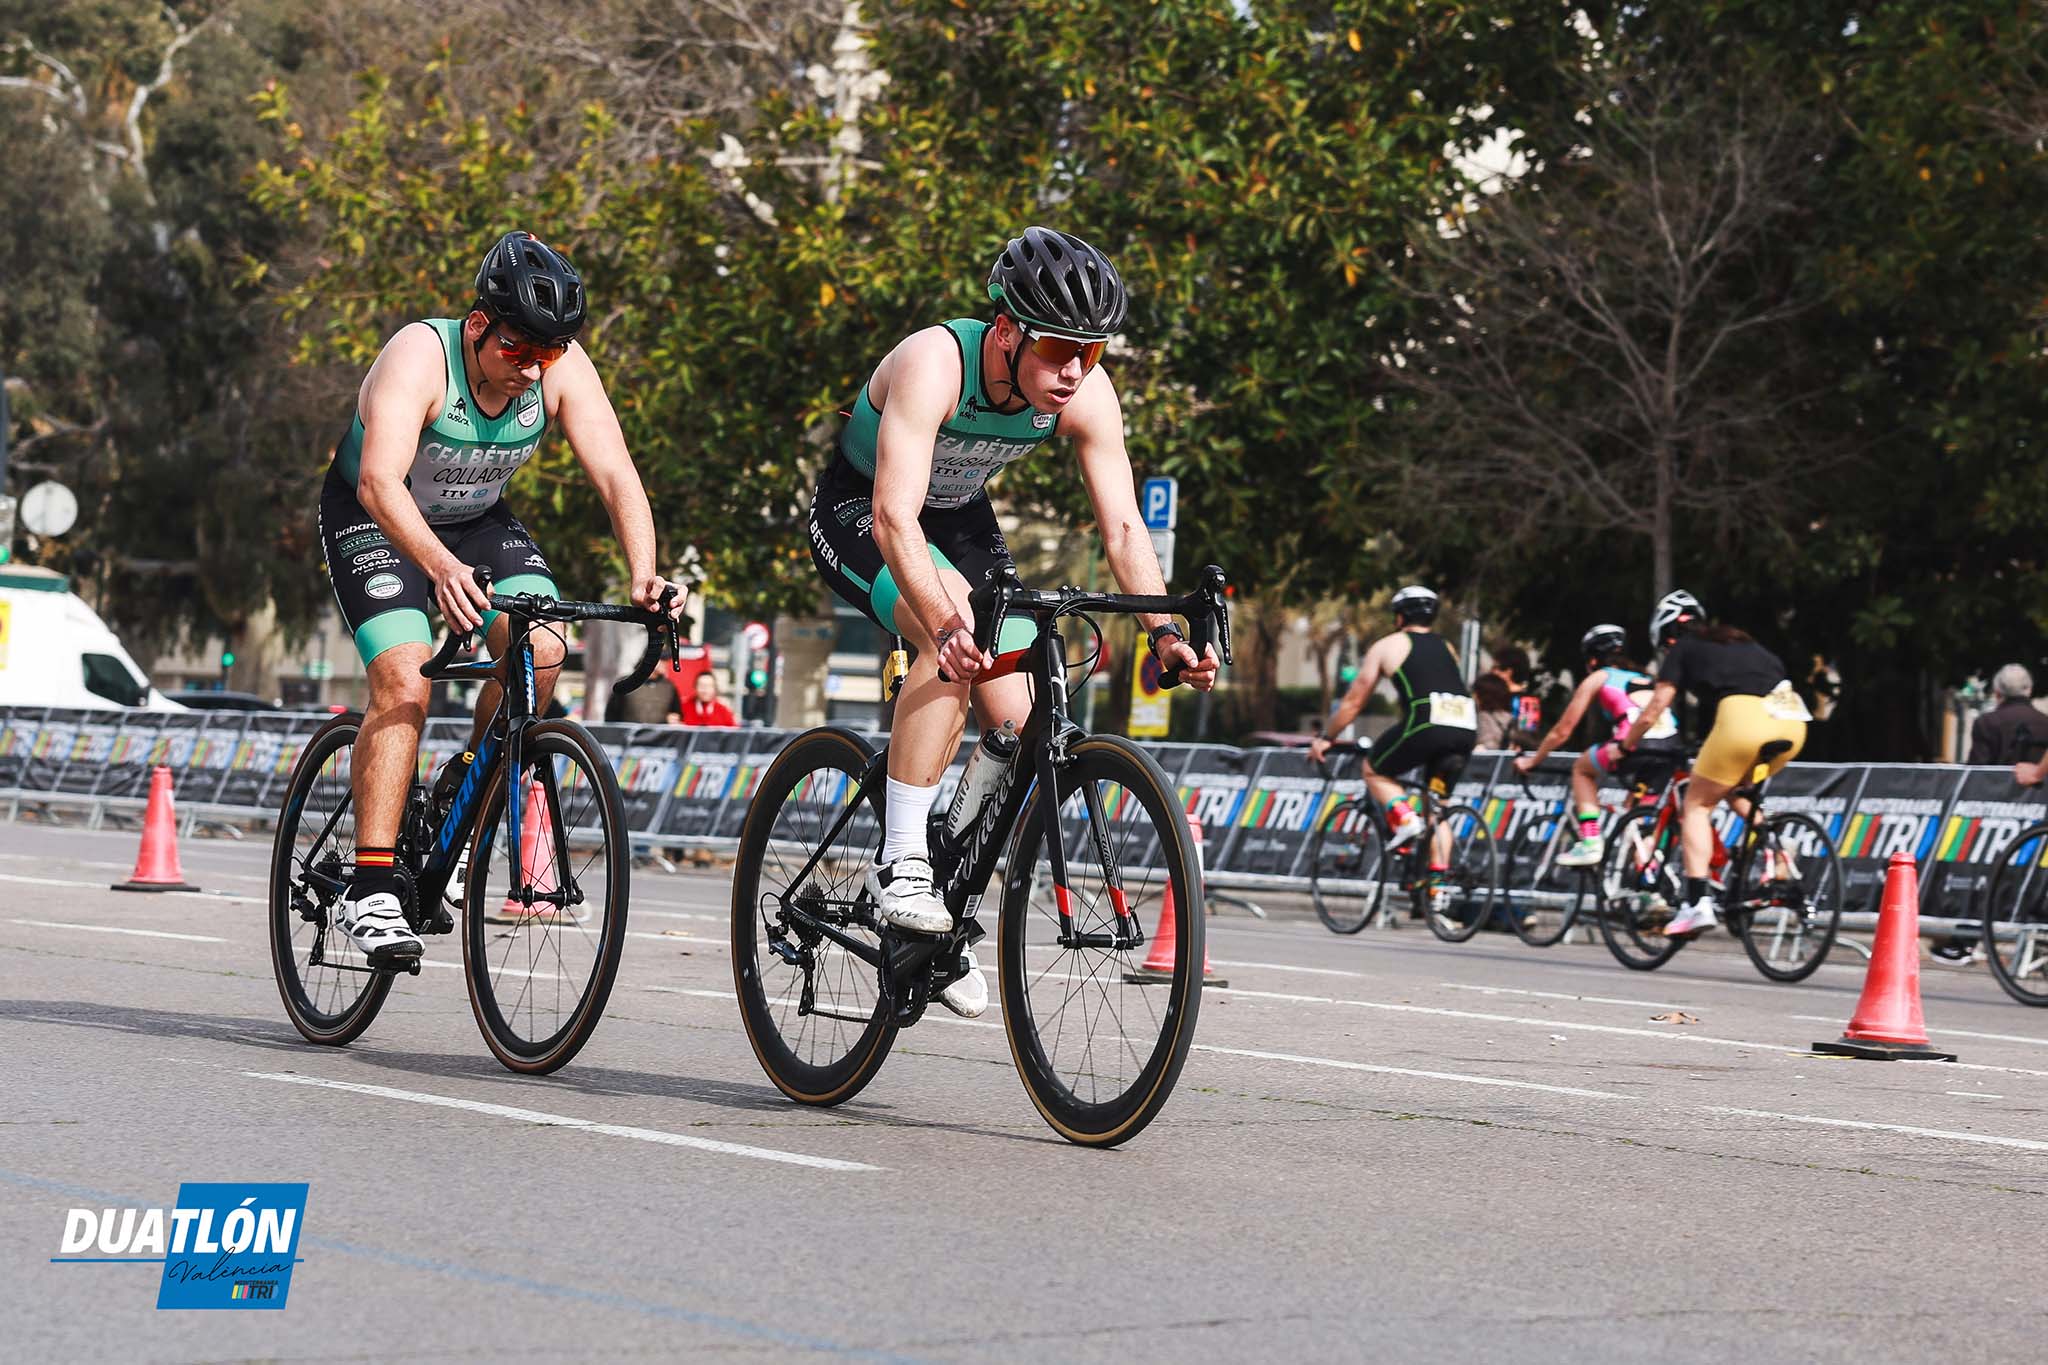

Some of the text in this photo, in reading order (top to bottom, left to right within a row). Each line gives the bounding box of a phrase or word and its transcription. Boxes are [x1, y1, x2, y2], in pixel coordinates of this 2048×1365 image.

[934, 466, 962, 475] ITV
[440, 489, 469, 498] ITV
[1148, 486, 1167, 521] P
[810, 520, 839, 572] BÉTERA
[441, 739, 495, 854] GIANT
[1266, 791, 1314, 831] TRI
